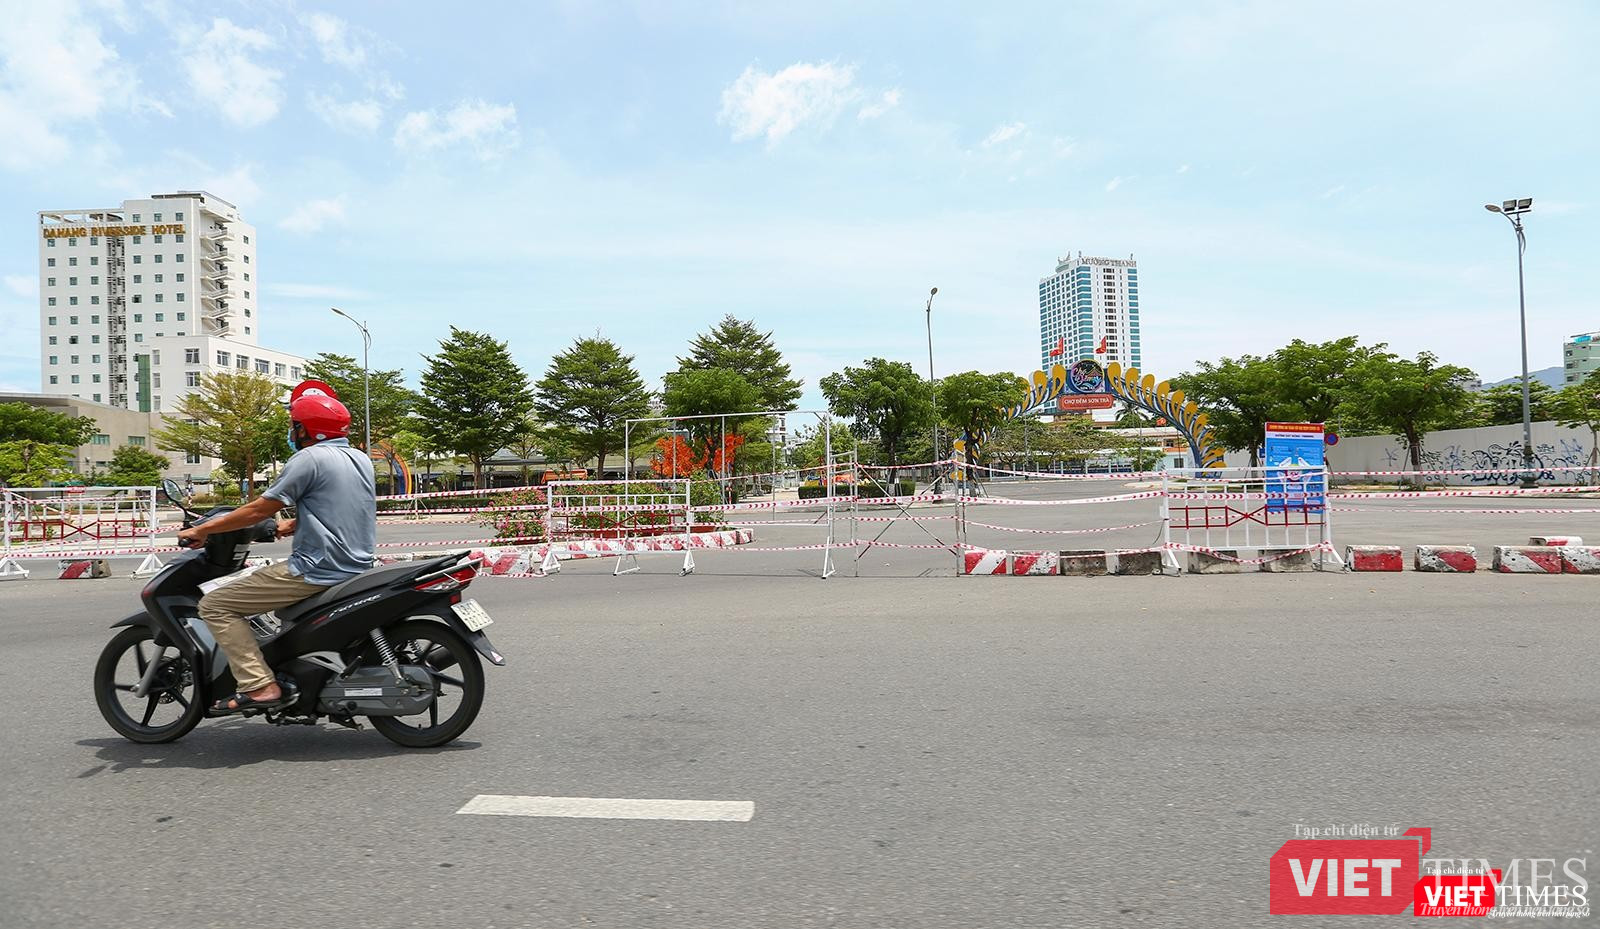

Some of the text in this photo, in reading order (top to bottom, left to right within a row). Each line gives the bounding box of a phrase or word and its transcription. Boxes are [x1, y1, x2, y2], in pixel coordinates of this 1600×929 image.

[91, 225, 147, 237] RIVERSIDE
[151, 224, 186, 235] HOTEL
[1110, 259, 1137, 267] THANH
